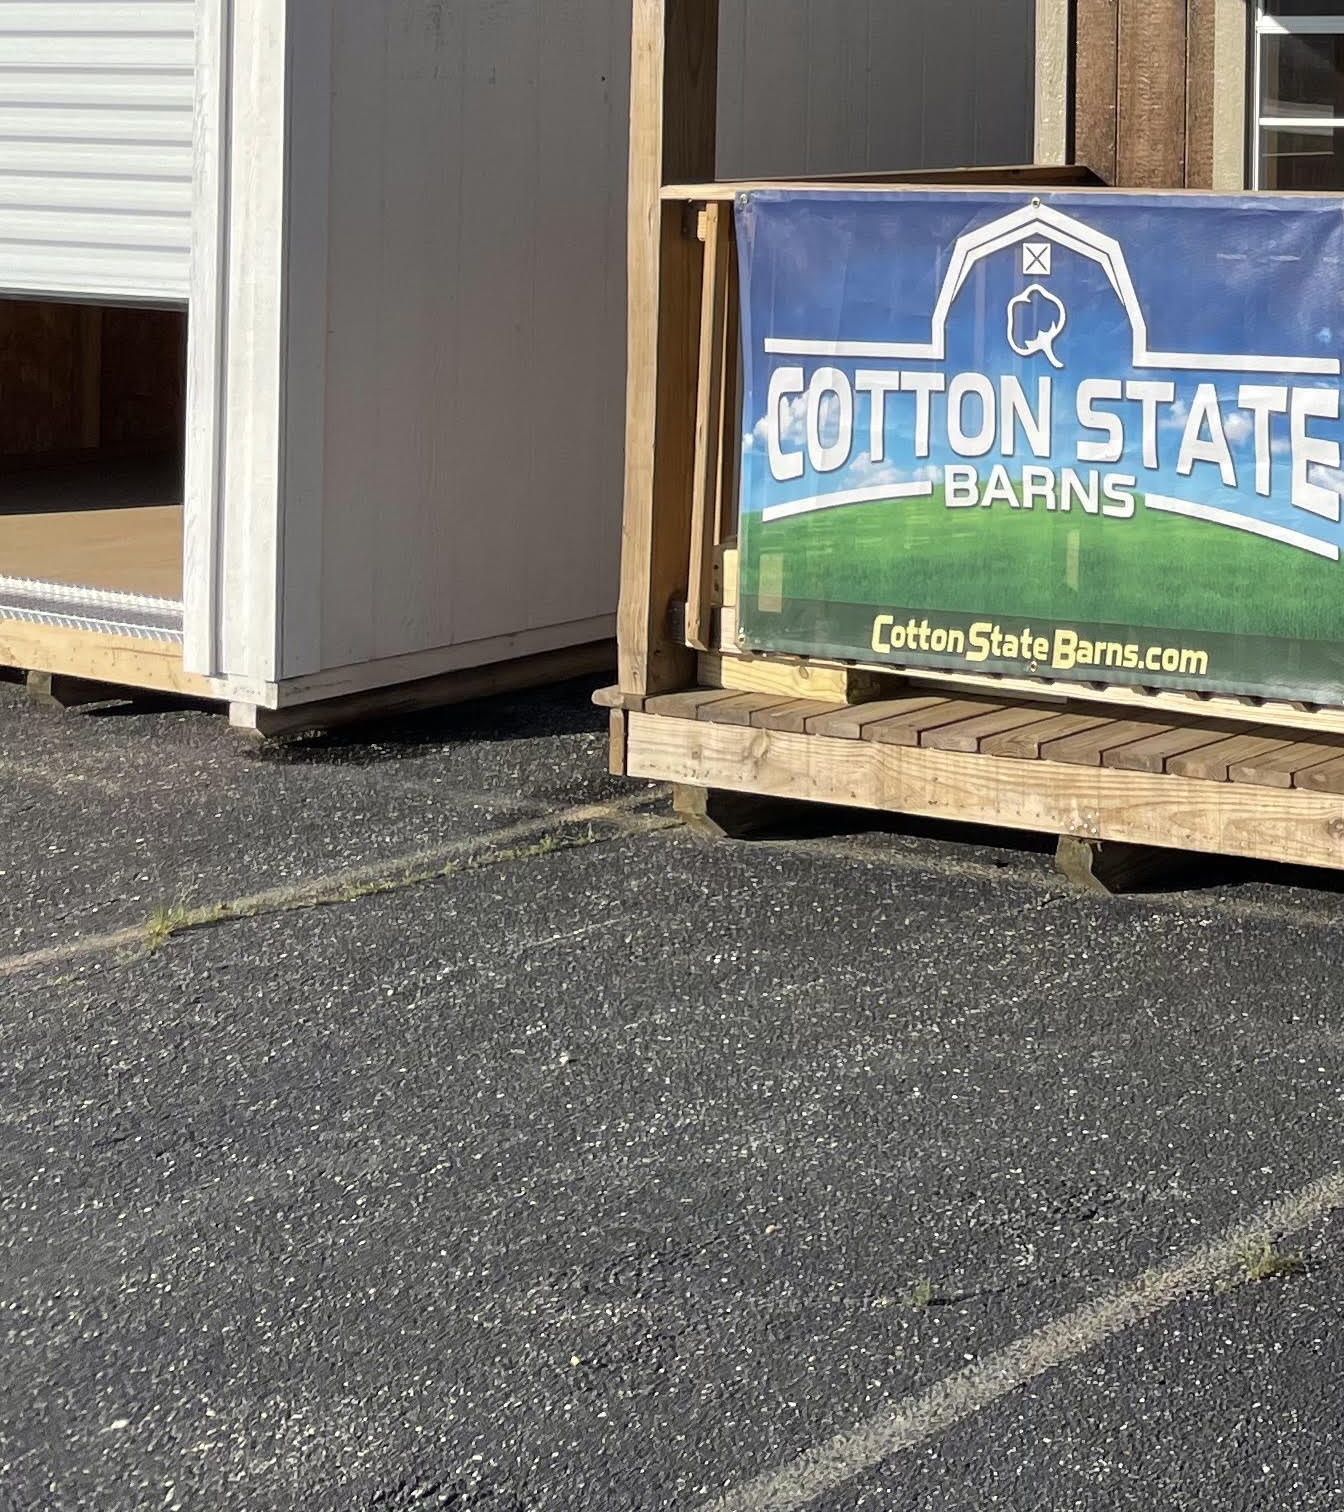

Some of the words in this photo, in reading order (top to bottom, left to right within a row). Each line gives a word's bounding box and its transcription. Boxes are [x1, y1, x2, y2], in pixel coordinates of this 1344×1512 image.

[764, 366, 1053, 481] COTTON
[1076, 379, 1340, 521] STATE
[944, 464, 1136, 518] BARNS
